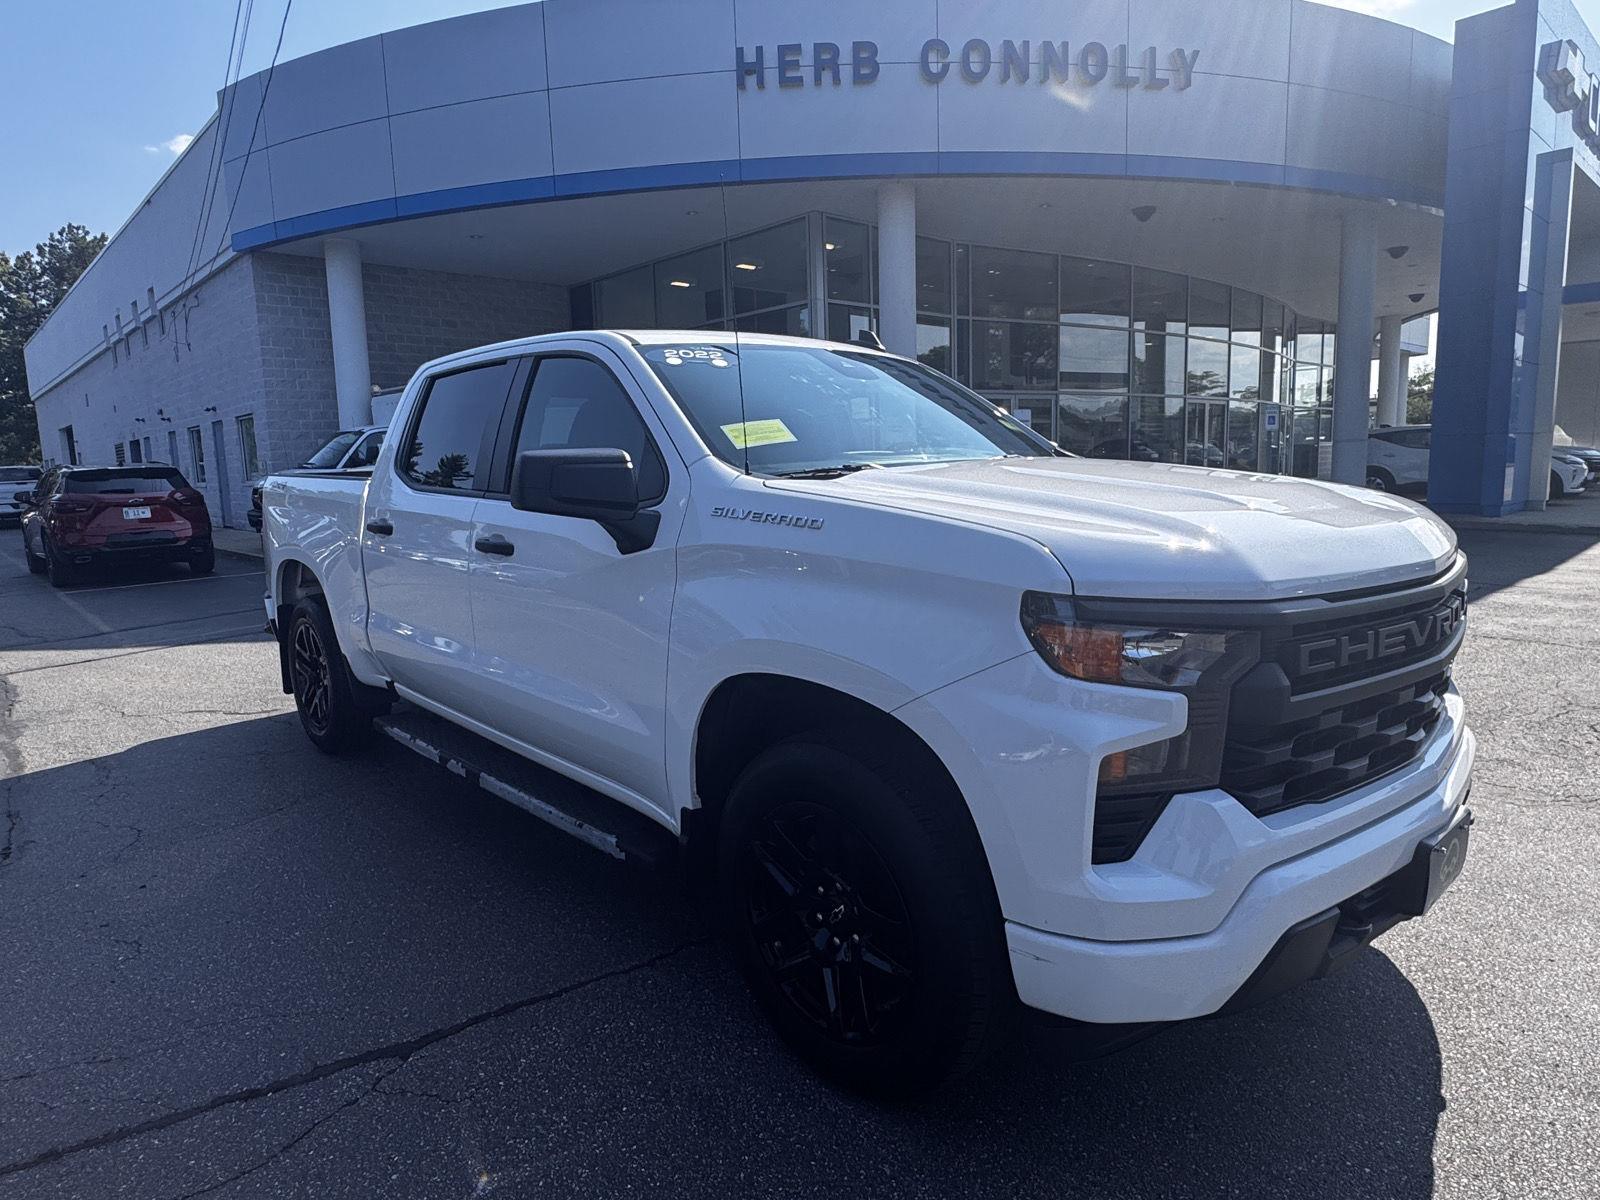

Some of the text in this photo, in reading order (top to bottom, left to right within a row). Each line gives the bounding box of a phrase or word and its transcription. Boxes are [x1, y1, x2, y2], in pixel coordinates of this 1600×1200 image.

[736, 38, 1201, 91] HERB CONNOLLY
[663, 348, 724, 360] 2022
[711, 506, 825, 530] SILVERADO
